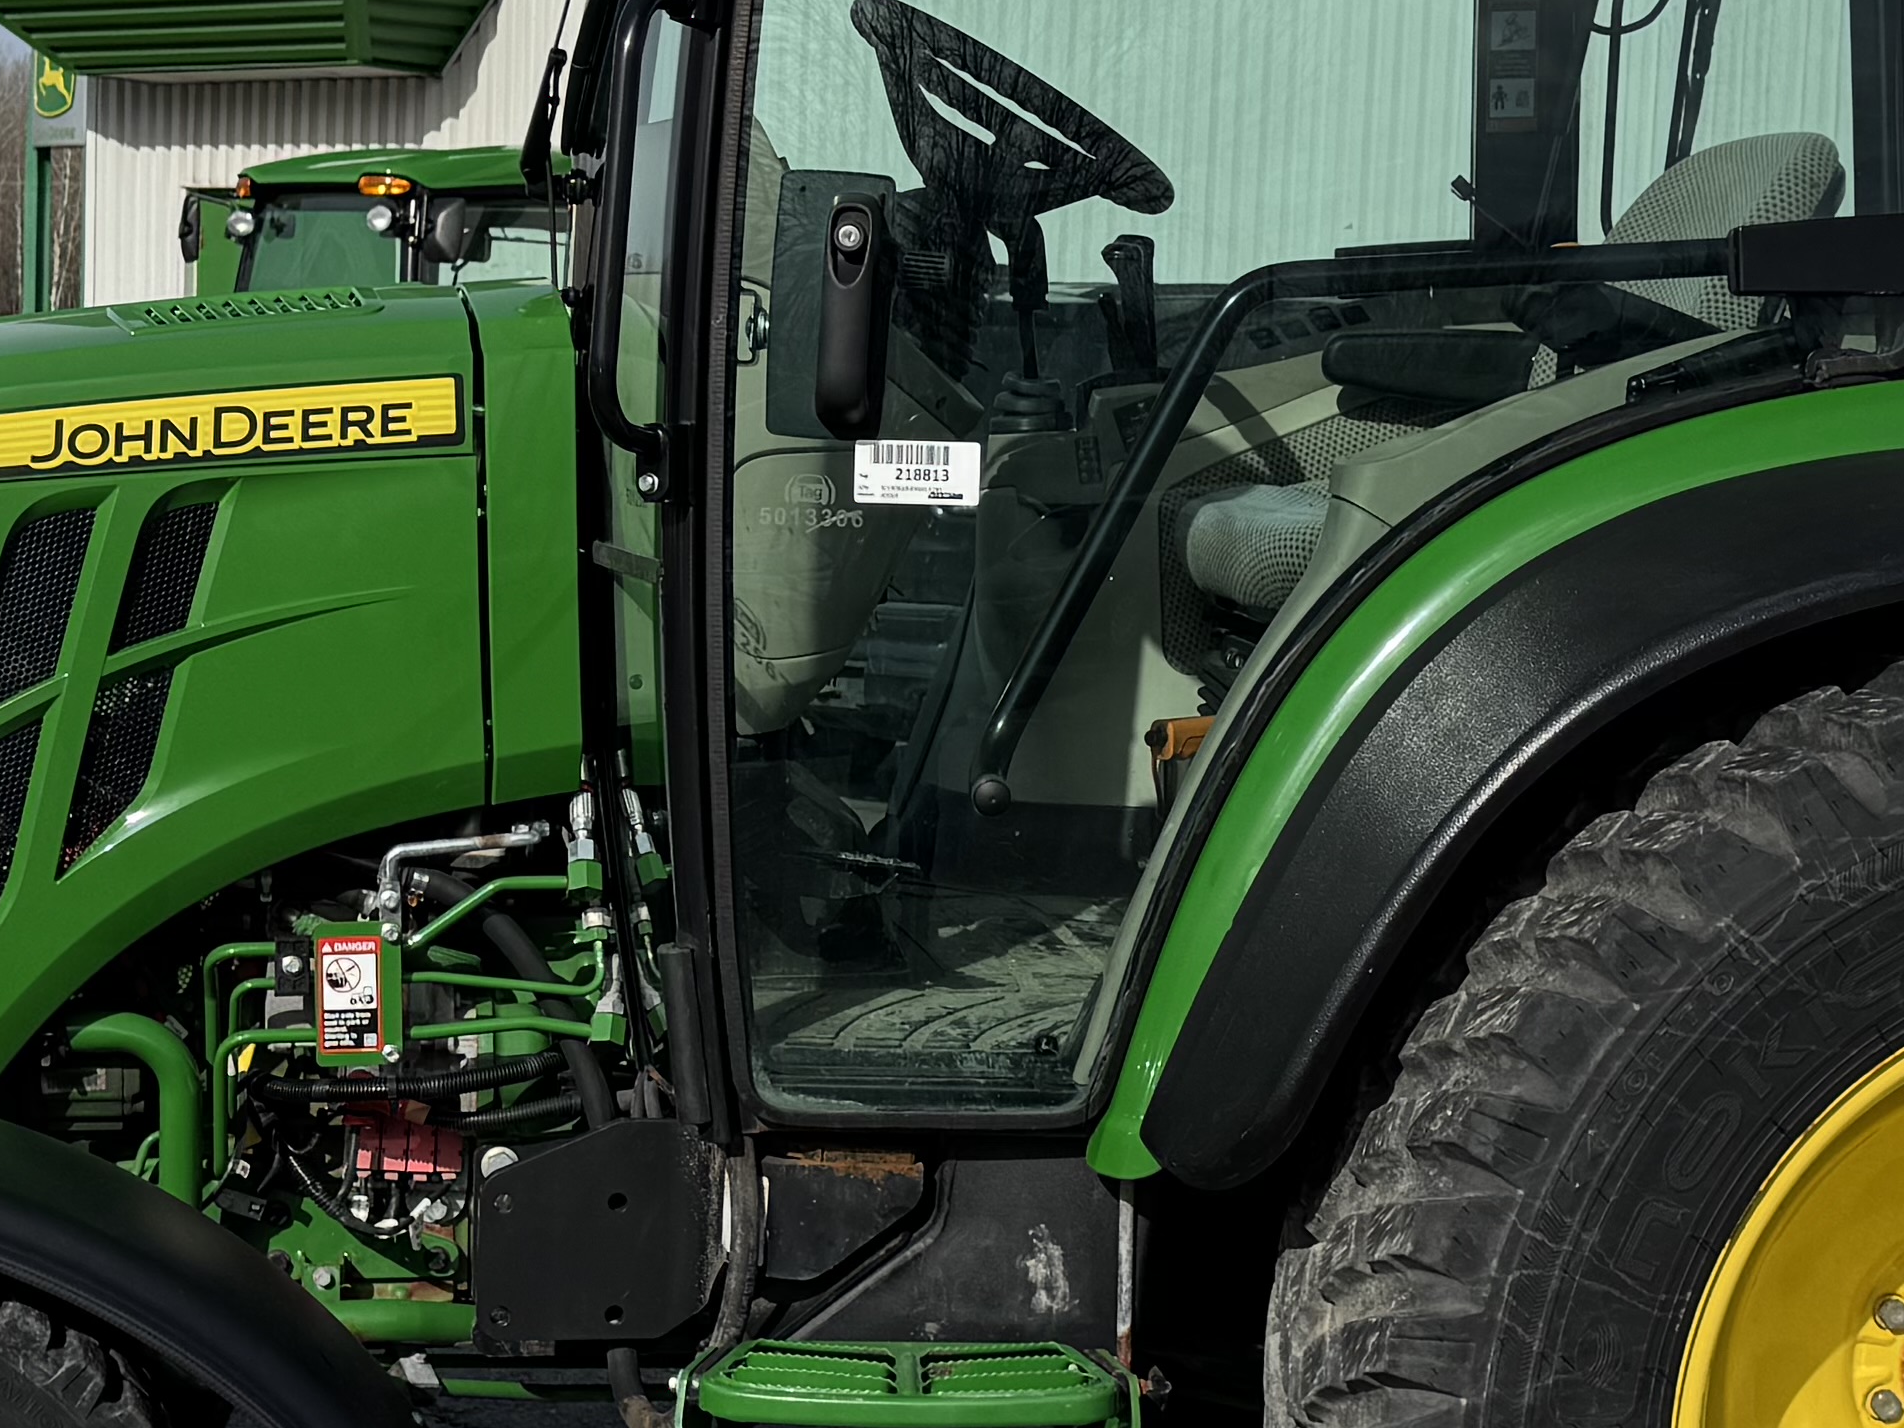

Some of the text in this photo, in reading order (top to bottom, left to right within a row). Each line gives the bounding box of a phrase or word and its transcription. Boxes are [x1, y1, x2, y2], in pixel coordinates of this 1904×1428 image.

[28, 402, 413, 466] JOHN DEERE
[895, 468, 950, 482] 218813
[799, 485, 823, 501] Tag
[333, 941, 376, 952] DANGER
